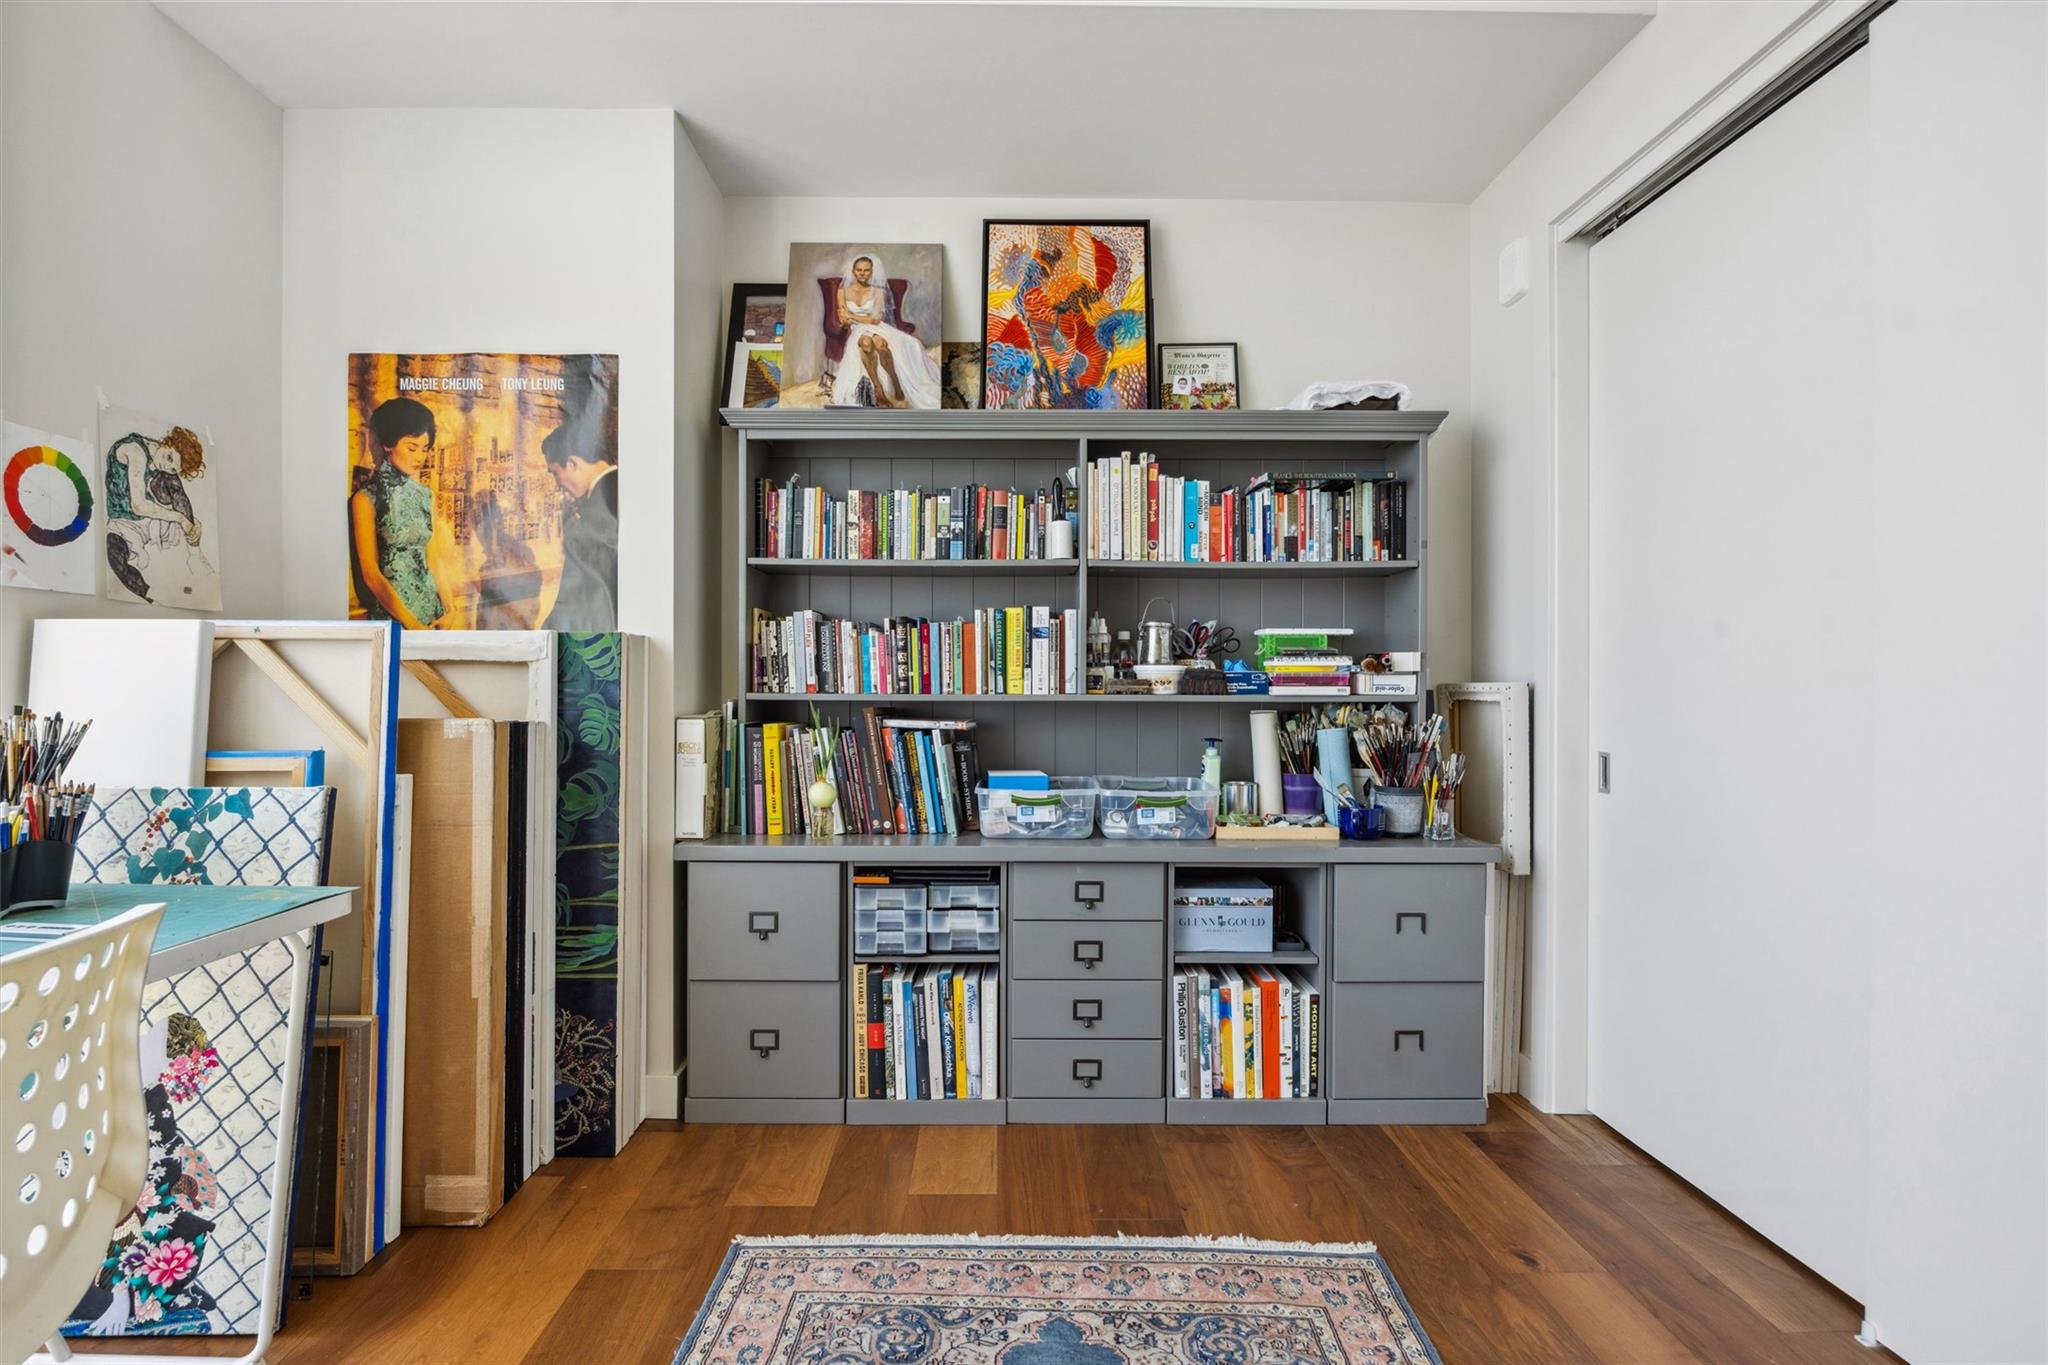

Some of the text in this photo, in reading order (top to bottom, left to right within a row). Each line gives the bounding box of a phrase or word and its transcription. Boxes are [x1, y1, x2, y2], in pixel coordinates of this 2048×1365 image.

[400, 377, 564, 391] MAGGIE CHEUNG TONY LEUNG
[960, 762, 968, 782] BOOK
[963, 788, 972, 821] SYMBOLS
[1178, 918, 1266, 926] GLENN GOULD
[966, 984, 976, 1024] Ai Weiwei
[1176, 982, 1186, 1040] Philip Guston
[944, 1012, 952, 1078] Oskar Kokoschka
